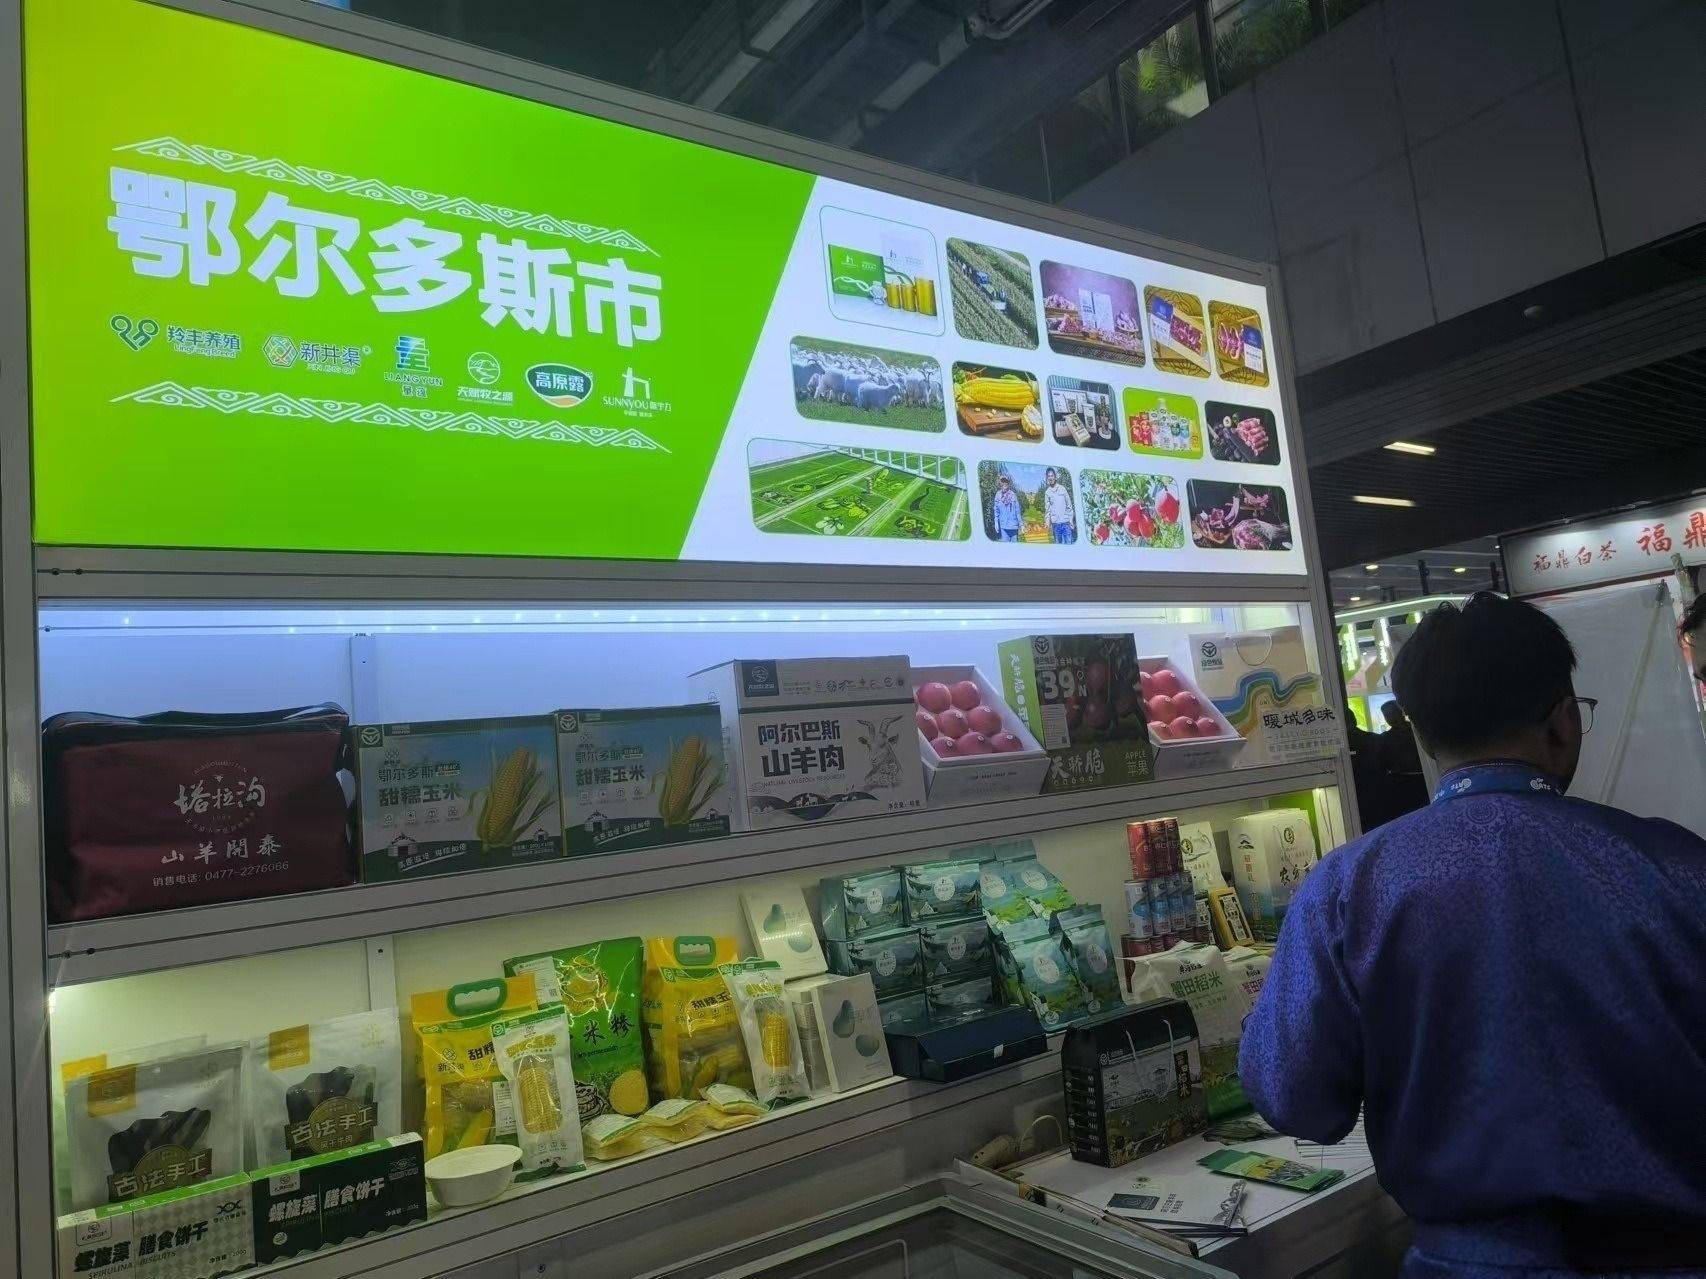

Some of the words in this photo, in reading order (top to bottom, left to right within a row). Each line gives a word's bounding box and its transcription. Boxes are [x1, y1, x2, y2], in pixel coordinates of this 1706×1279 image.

[107, 166, 663, 348] 鄂尔多斯市
[300, 343, 361, 366] 新井渠
[535, 371, 585, 393] 高原露
[1533, 541, 1617, 574] 福鼎白茶
[1263, 708, 1336, 729] 暖城多味
[757, 720, 841, 745] 阿尔巴斯
[761, 744, 845, 778] 山羊肉
[1124, 750, 1146, 760] APPLE
[576, 765, 645, 786] 甜糯玉米
[1126, 760, 1149, 776] 苹果
[378, 784, 462, 807] 甜糯玉米
[291, 1106, 374, 1145] 古法手工
[114, 1152, 206, 1197] 古法手工
